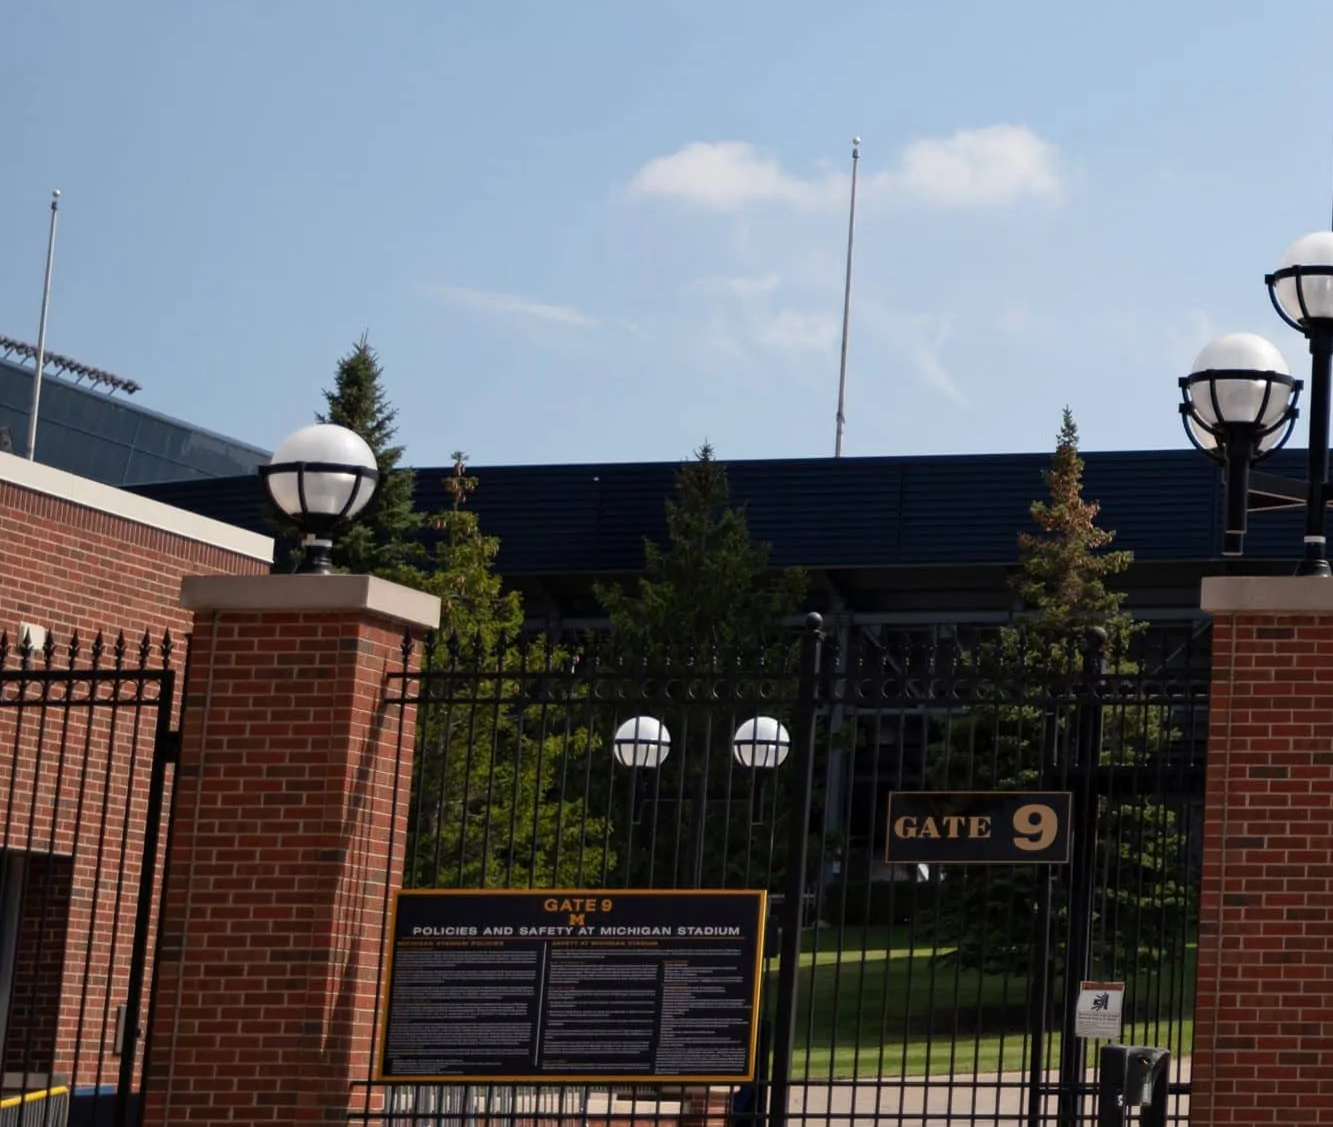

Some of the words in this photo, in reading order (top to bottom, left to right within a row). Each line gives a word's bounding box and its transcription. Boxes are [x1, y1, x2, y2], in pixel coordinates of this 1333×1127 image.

[894, 815, 992, 839] GATE
[1012, 803, 1058, 851] 9
[544, 898, 597, 912] GATE
[601, 898, 613, 912] 9
[569, 914, 585, 926] M
[412, 926, 478, 936] POLICIES
[483, 926, 513, 936] AND
[519, 926, 573, 936] SAFETY
[578, 926, 595, 936] AT
[600, 926, 672, 936] MICHIGAN
[677, 926, 740, 936] STADIUM
